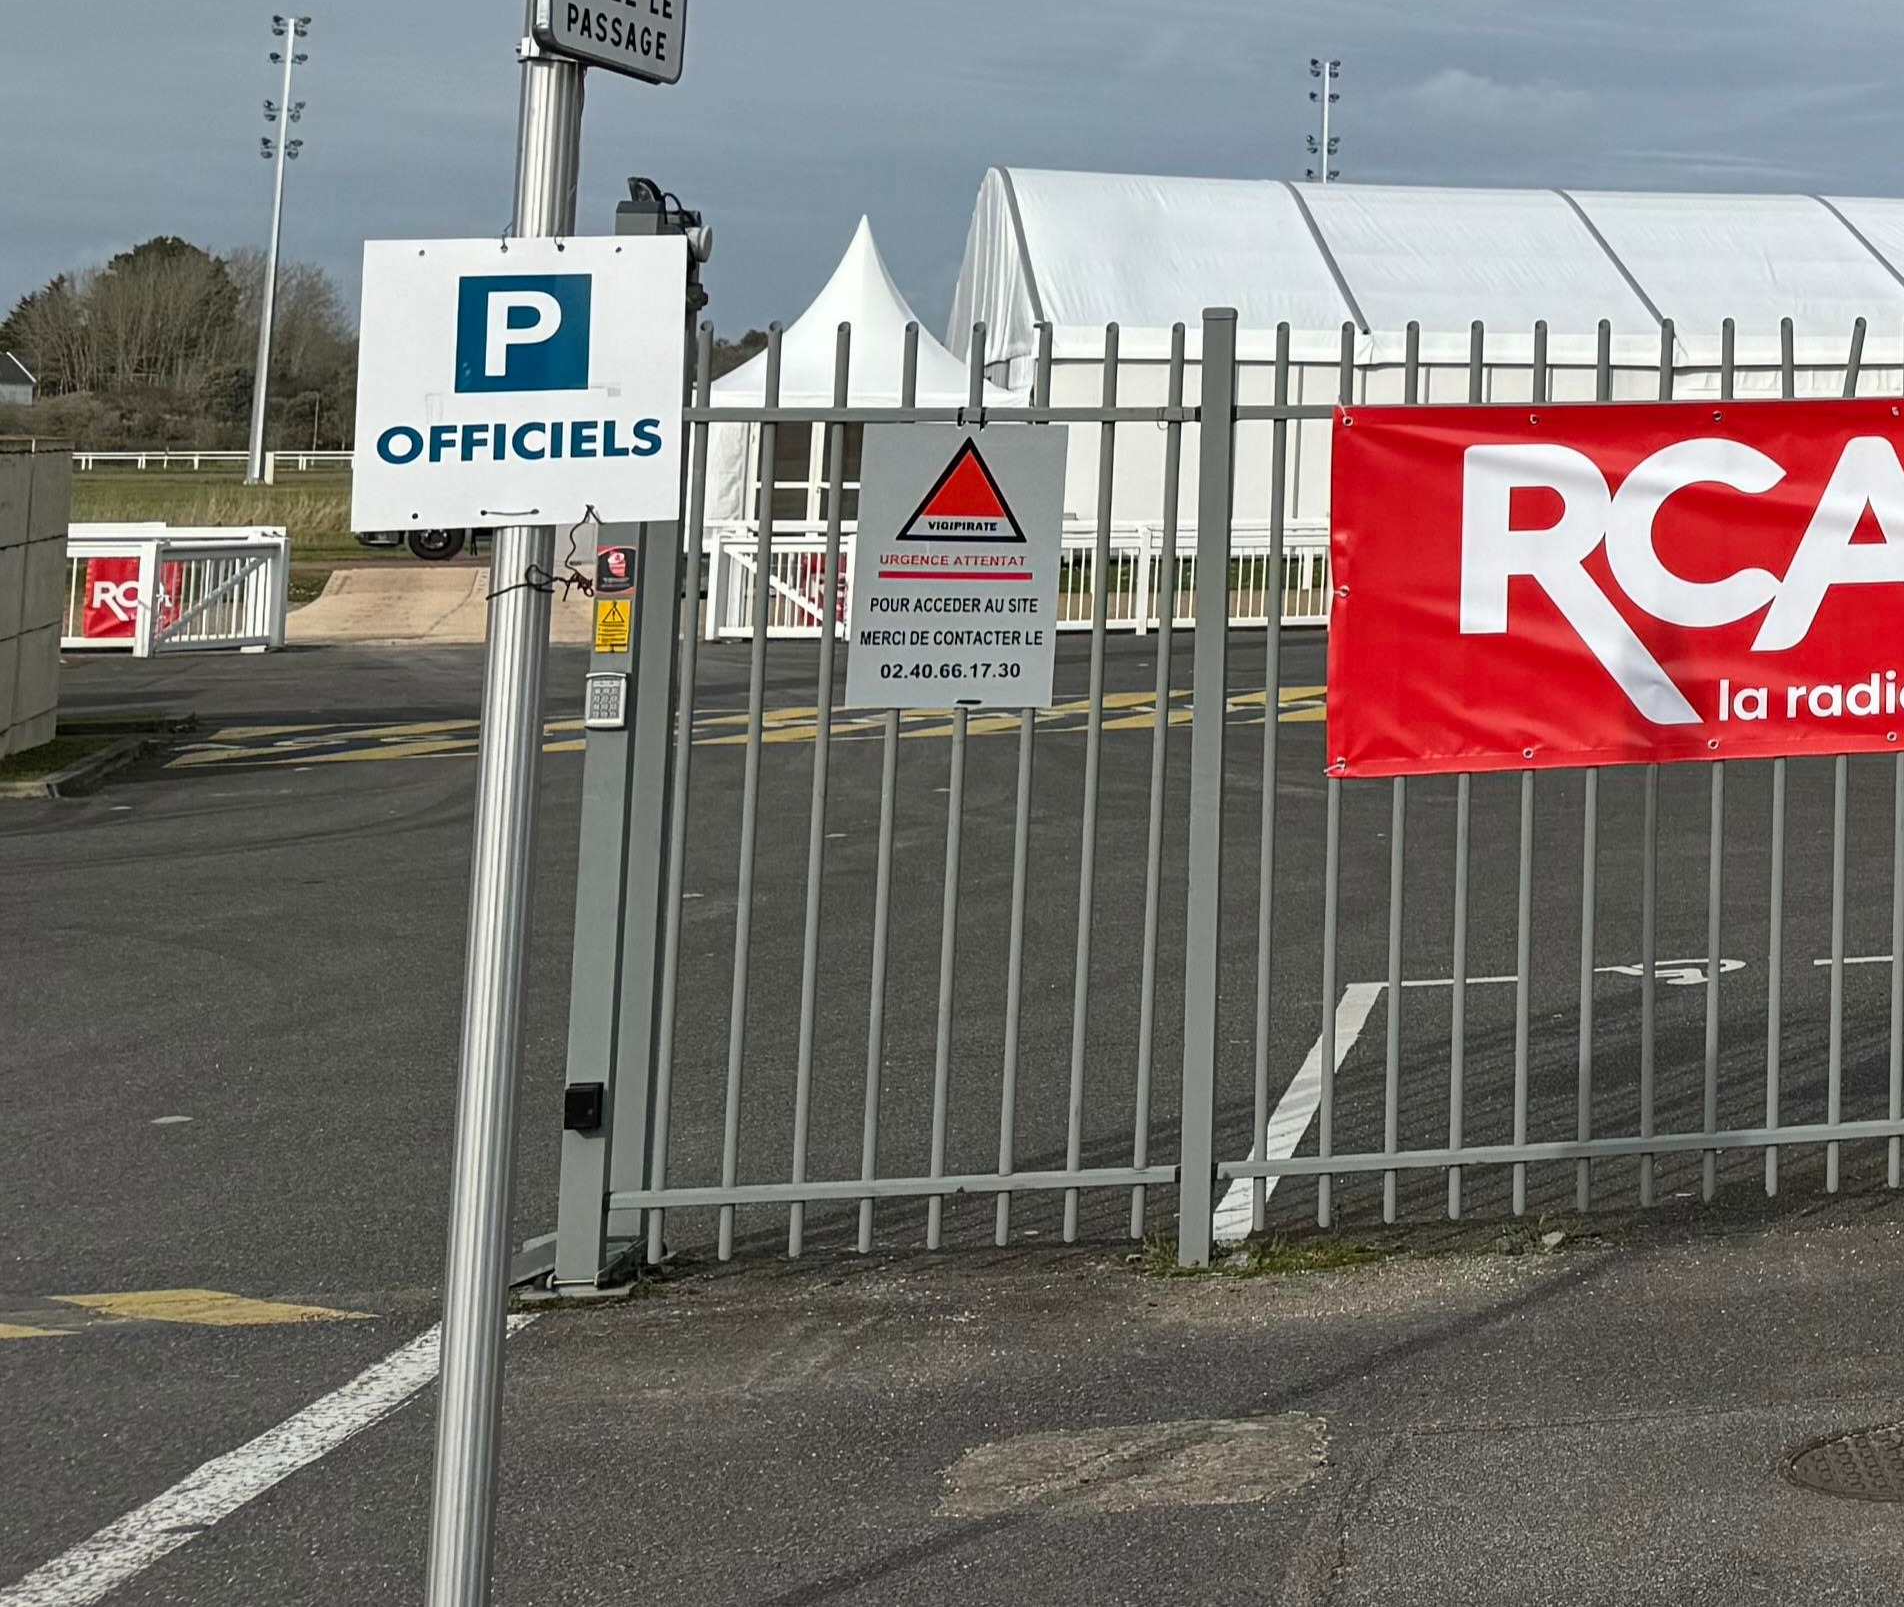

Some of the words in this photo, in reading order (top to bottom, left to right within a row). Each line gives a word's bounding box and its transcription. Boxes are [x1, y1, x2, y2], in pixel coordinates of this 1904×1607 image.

[567, 2, 667, 61] PASSAGE
[484, 290, 562, 377] P
[376, 418, 662, 465] OFFICIELS
[927, 520, 998, 532] VIGIPIRATE
[879, 554, 949, 566] URGENCE
[953, 555, 1027, 566] ATTENTAT
[870, 597, 910, 612] POUR
[913, 597, 981, 612] ACCEDER
[984, 598, 1004, 612] AU
[1008, 598, 1039, 613] SITE
[860, 630, 906, 645] MERCI
[910, 631, 929, 645] DE
[933, 631, 1021, 646] CONTACTER
[1025, 631, 1043, 645] LE
[880, 663, 1021, 679] 02.40.66.17.30
[1718, 679, 1768, 722] la
